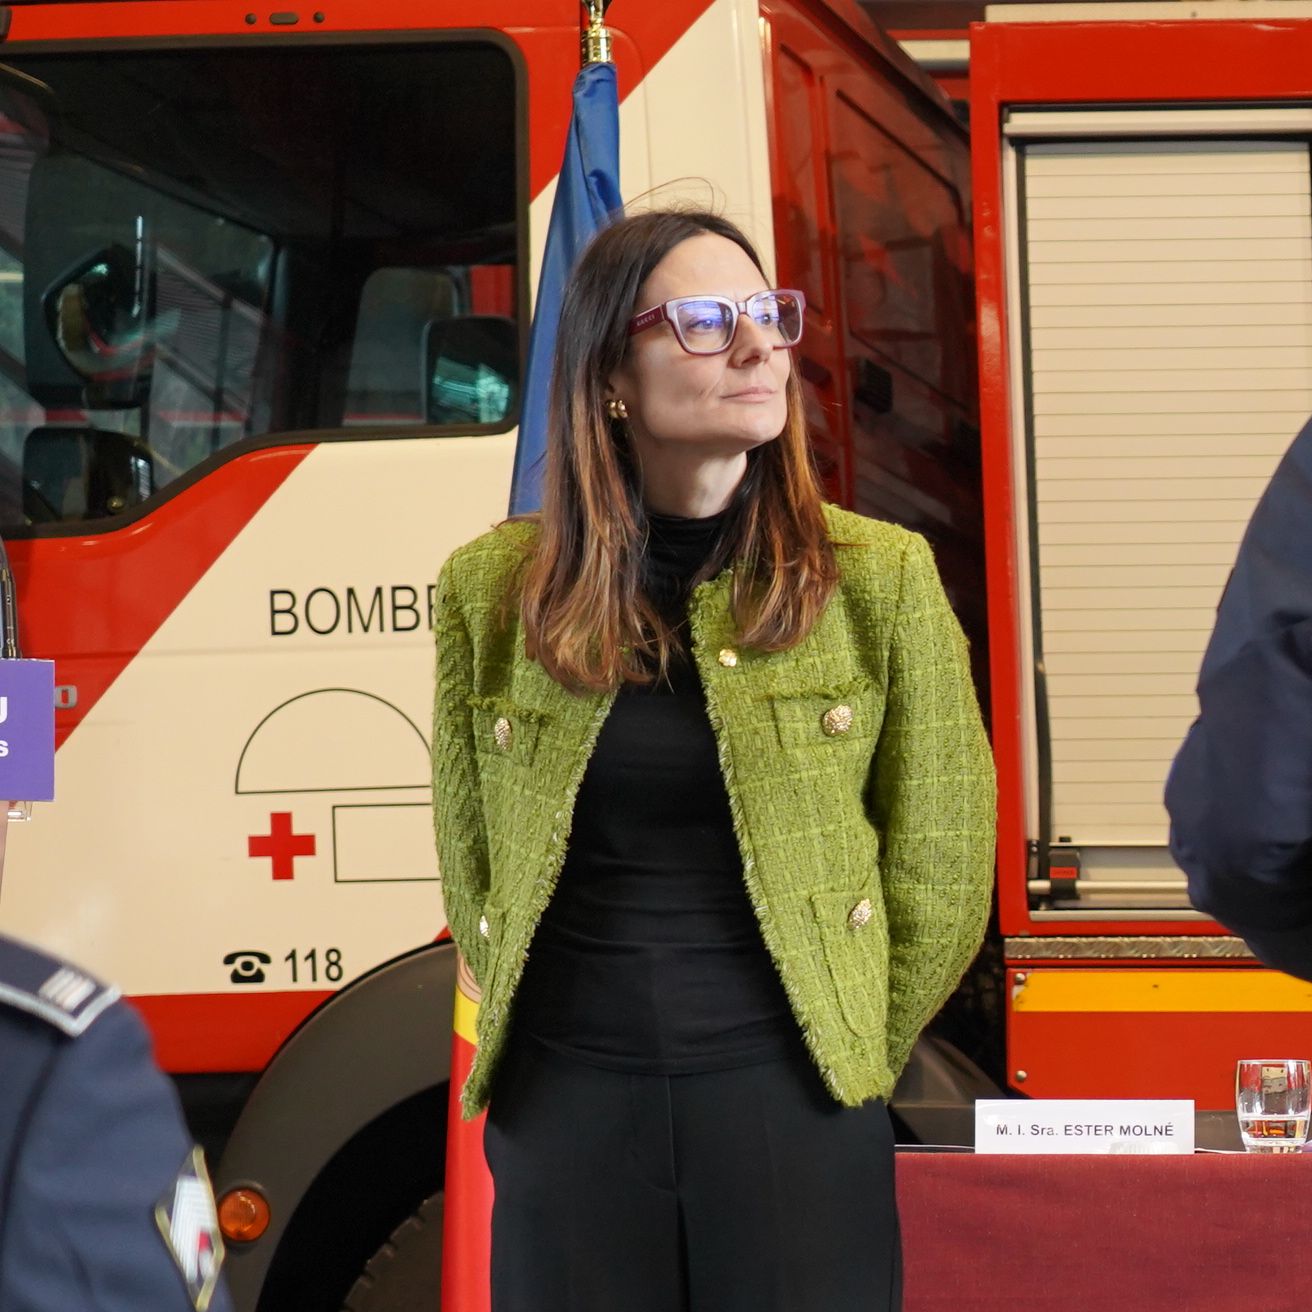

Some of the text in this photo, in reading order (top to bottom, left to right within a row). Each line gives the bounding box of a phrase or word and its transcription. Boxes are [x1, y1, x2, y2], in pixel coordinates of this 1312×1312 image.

[284, 947, 344, 983] 118
[996, 1124, 1013, 1136] M.
[1030, 1124, 1058, 1136] Sra.
[1064, 1124, 1114, 1136] ESTER
[1119, 1122, 1174, 1137] MOLNÉ
